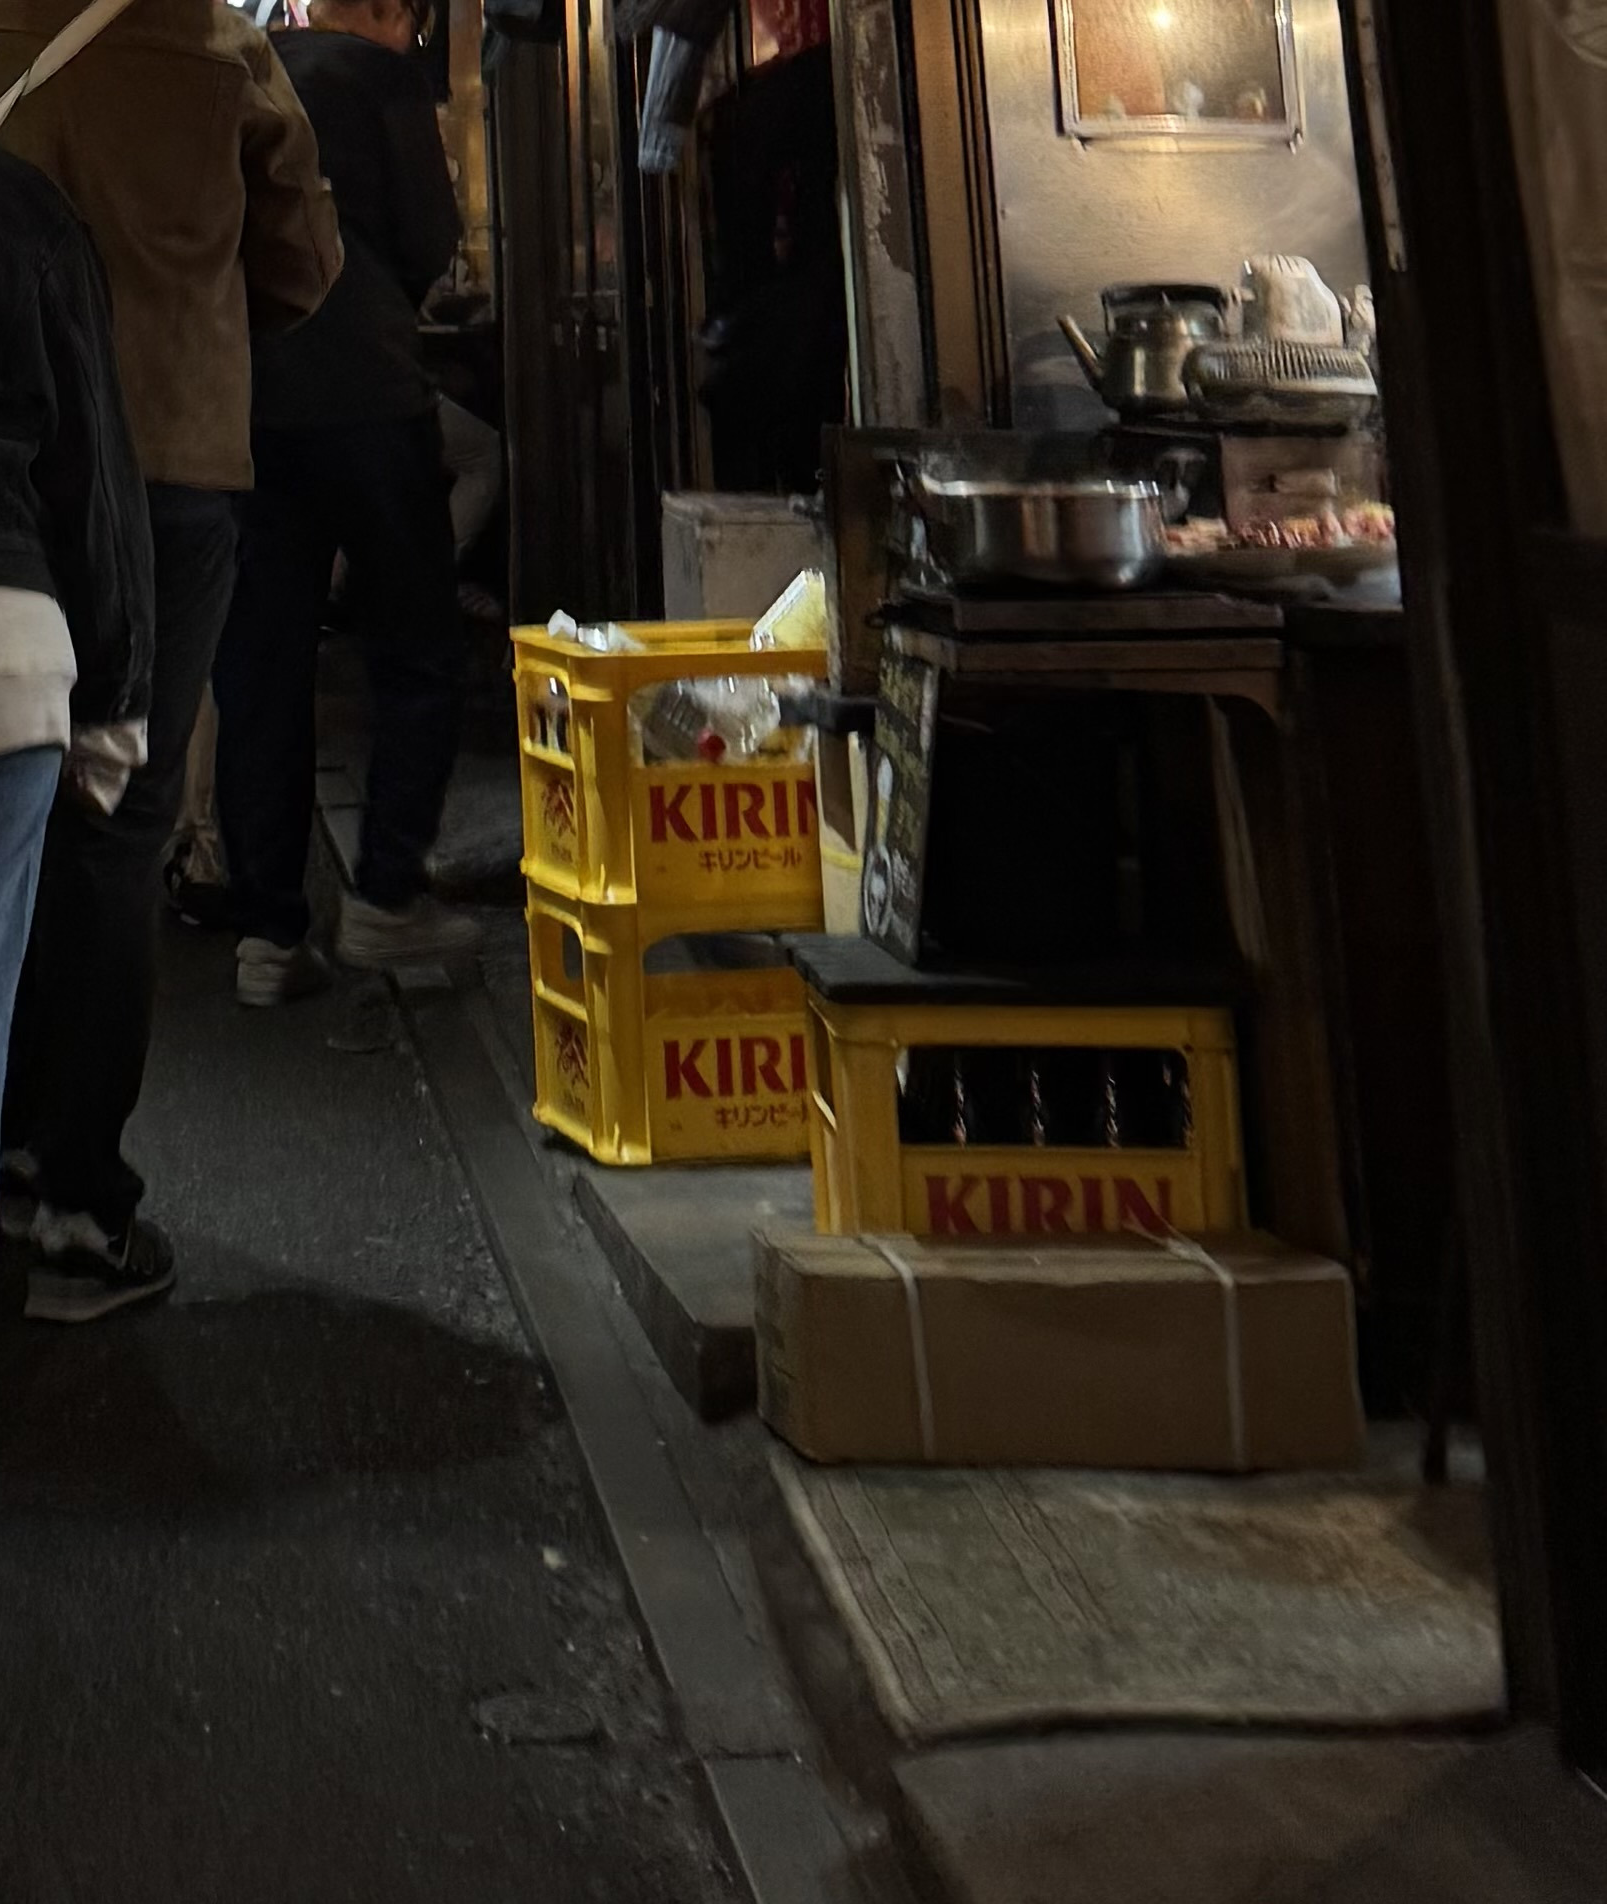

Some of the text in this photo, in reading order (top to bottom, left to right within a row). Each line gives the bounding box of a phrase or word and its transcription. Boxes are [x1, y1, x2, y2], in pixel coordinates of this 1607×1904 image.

[699, 847, 802, 873] キリンビール
[663, 1034, 808, 1099] KIRI
[924, 1175, 1173, 1236] KIRIN
